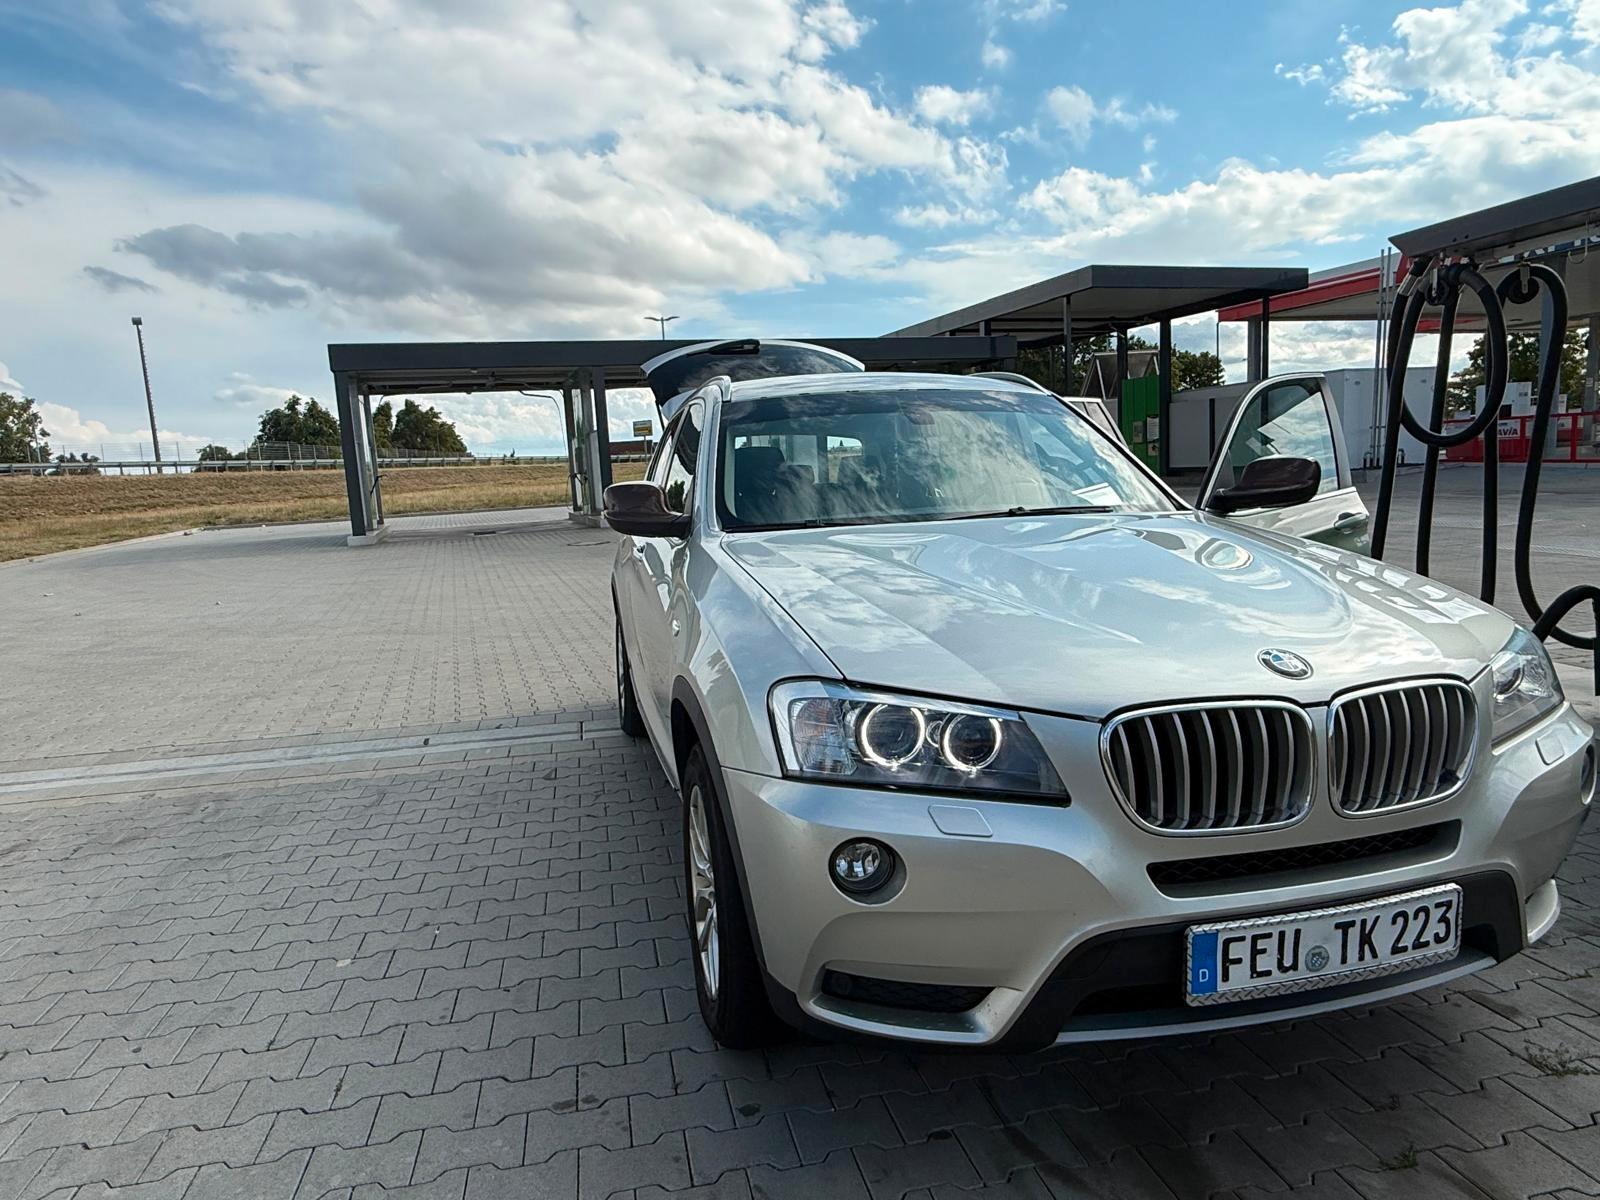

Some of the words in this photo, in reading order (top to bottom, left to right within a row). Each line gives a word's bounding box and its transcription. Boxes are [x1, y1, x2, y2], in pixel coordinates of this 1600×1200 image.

[1220, 928, 1302, 983] FEU
[1334, 915, 1381, 965] TK
[1390, 899, 1454, 956] 223
[1198, 968, 1209, 982] D
